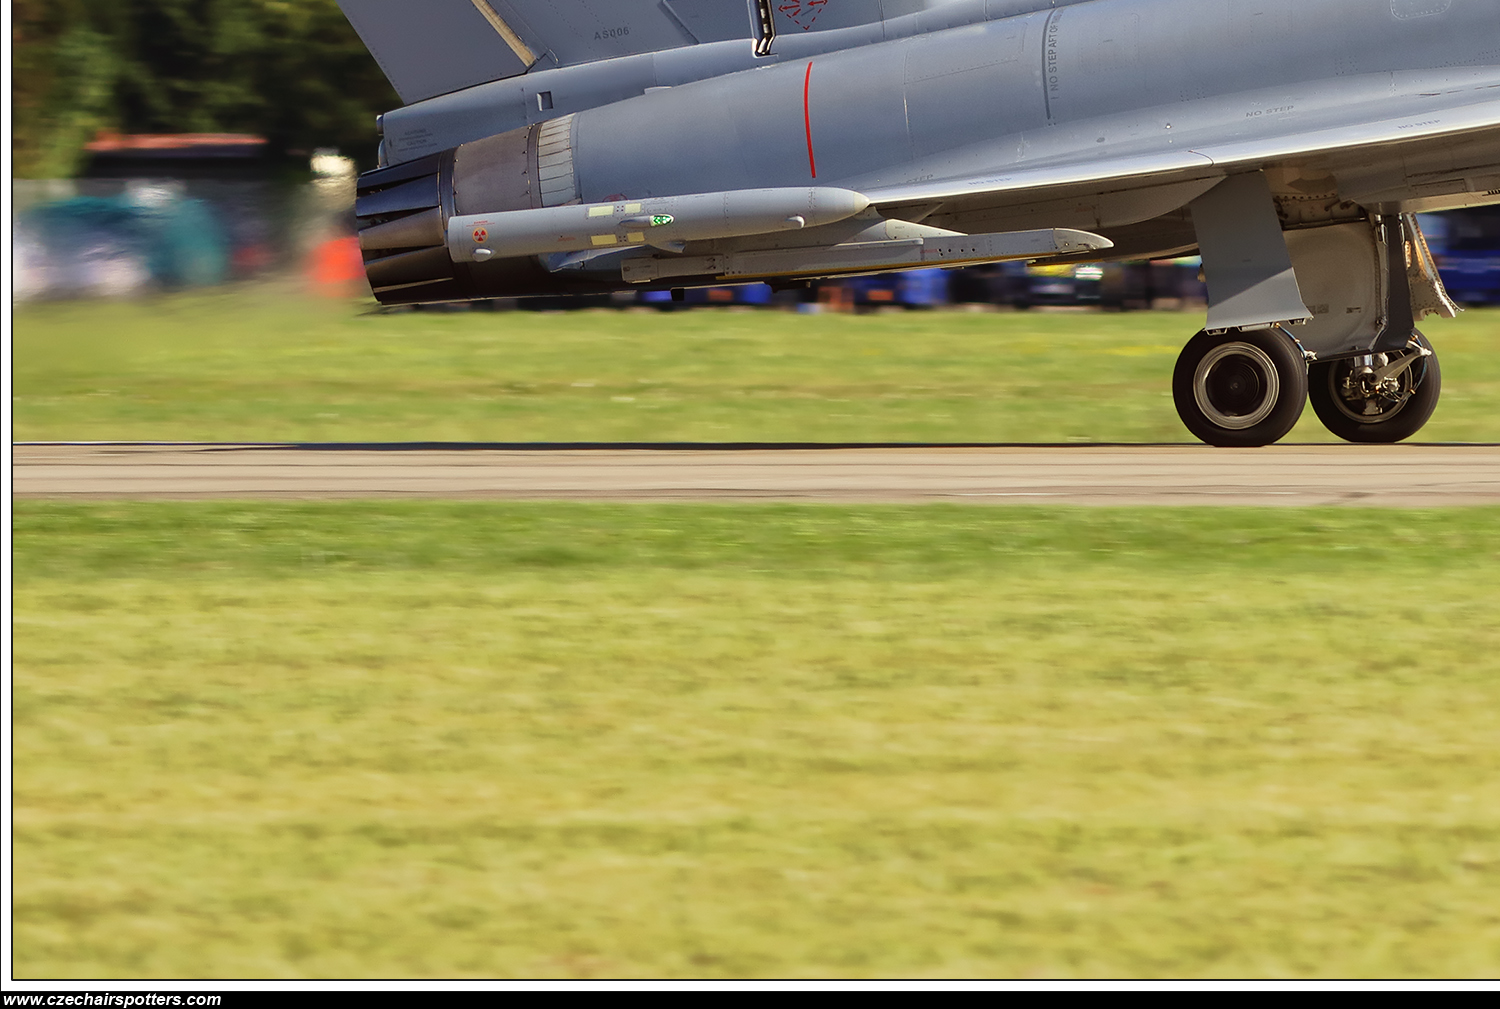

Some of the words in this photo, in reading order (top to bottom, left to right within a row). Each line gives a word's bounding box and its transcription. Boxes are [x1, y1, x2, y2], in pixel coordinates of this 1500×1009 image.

[594, 26, 630, 40] AS006
[1048, 34, 1057, 48] AFT
[1047, 49, 1057, 73] STEP
[1049, 75, 1059, 92] NO
[1246, 109, 1262, 118] NO
[1265, 105, 1294, 114] STEP
